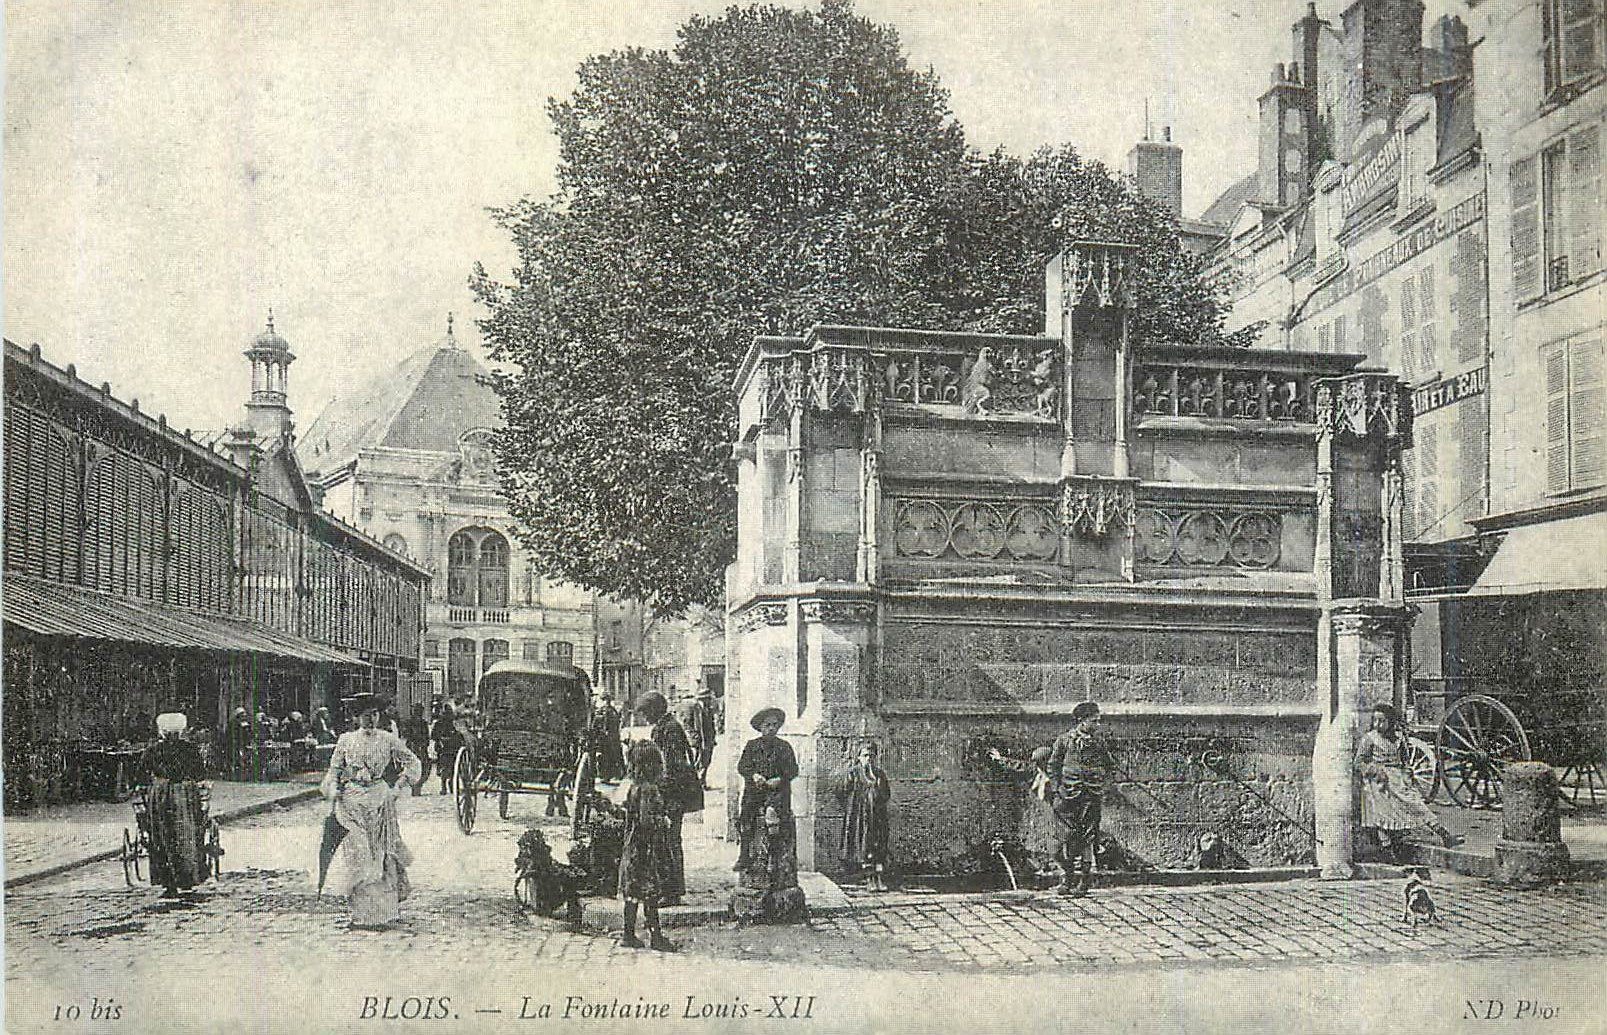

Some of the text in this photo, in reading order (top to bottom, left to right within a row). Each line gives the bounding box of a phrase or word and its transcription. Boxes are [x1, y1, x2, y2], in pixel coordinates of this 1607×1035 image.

[1416, 227, 1434, 251] DE
[1434, 194, 1484, 238] CUISINE
[1431, 387, 1443, 408] ET
[1446, 384, 1455, 404] A
[1457, 368, 1485, 398] EAU
